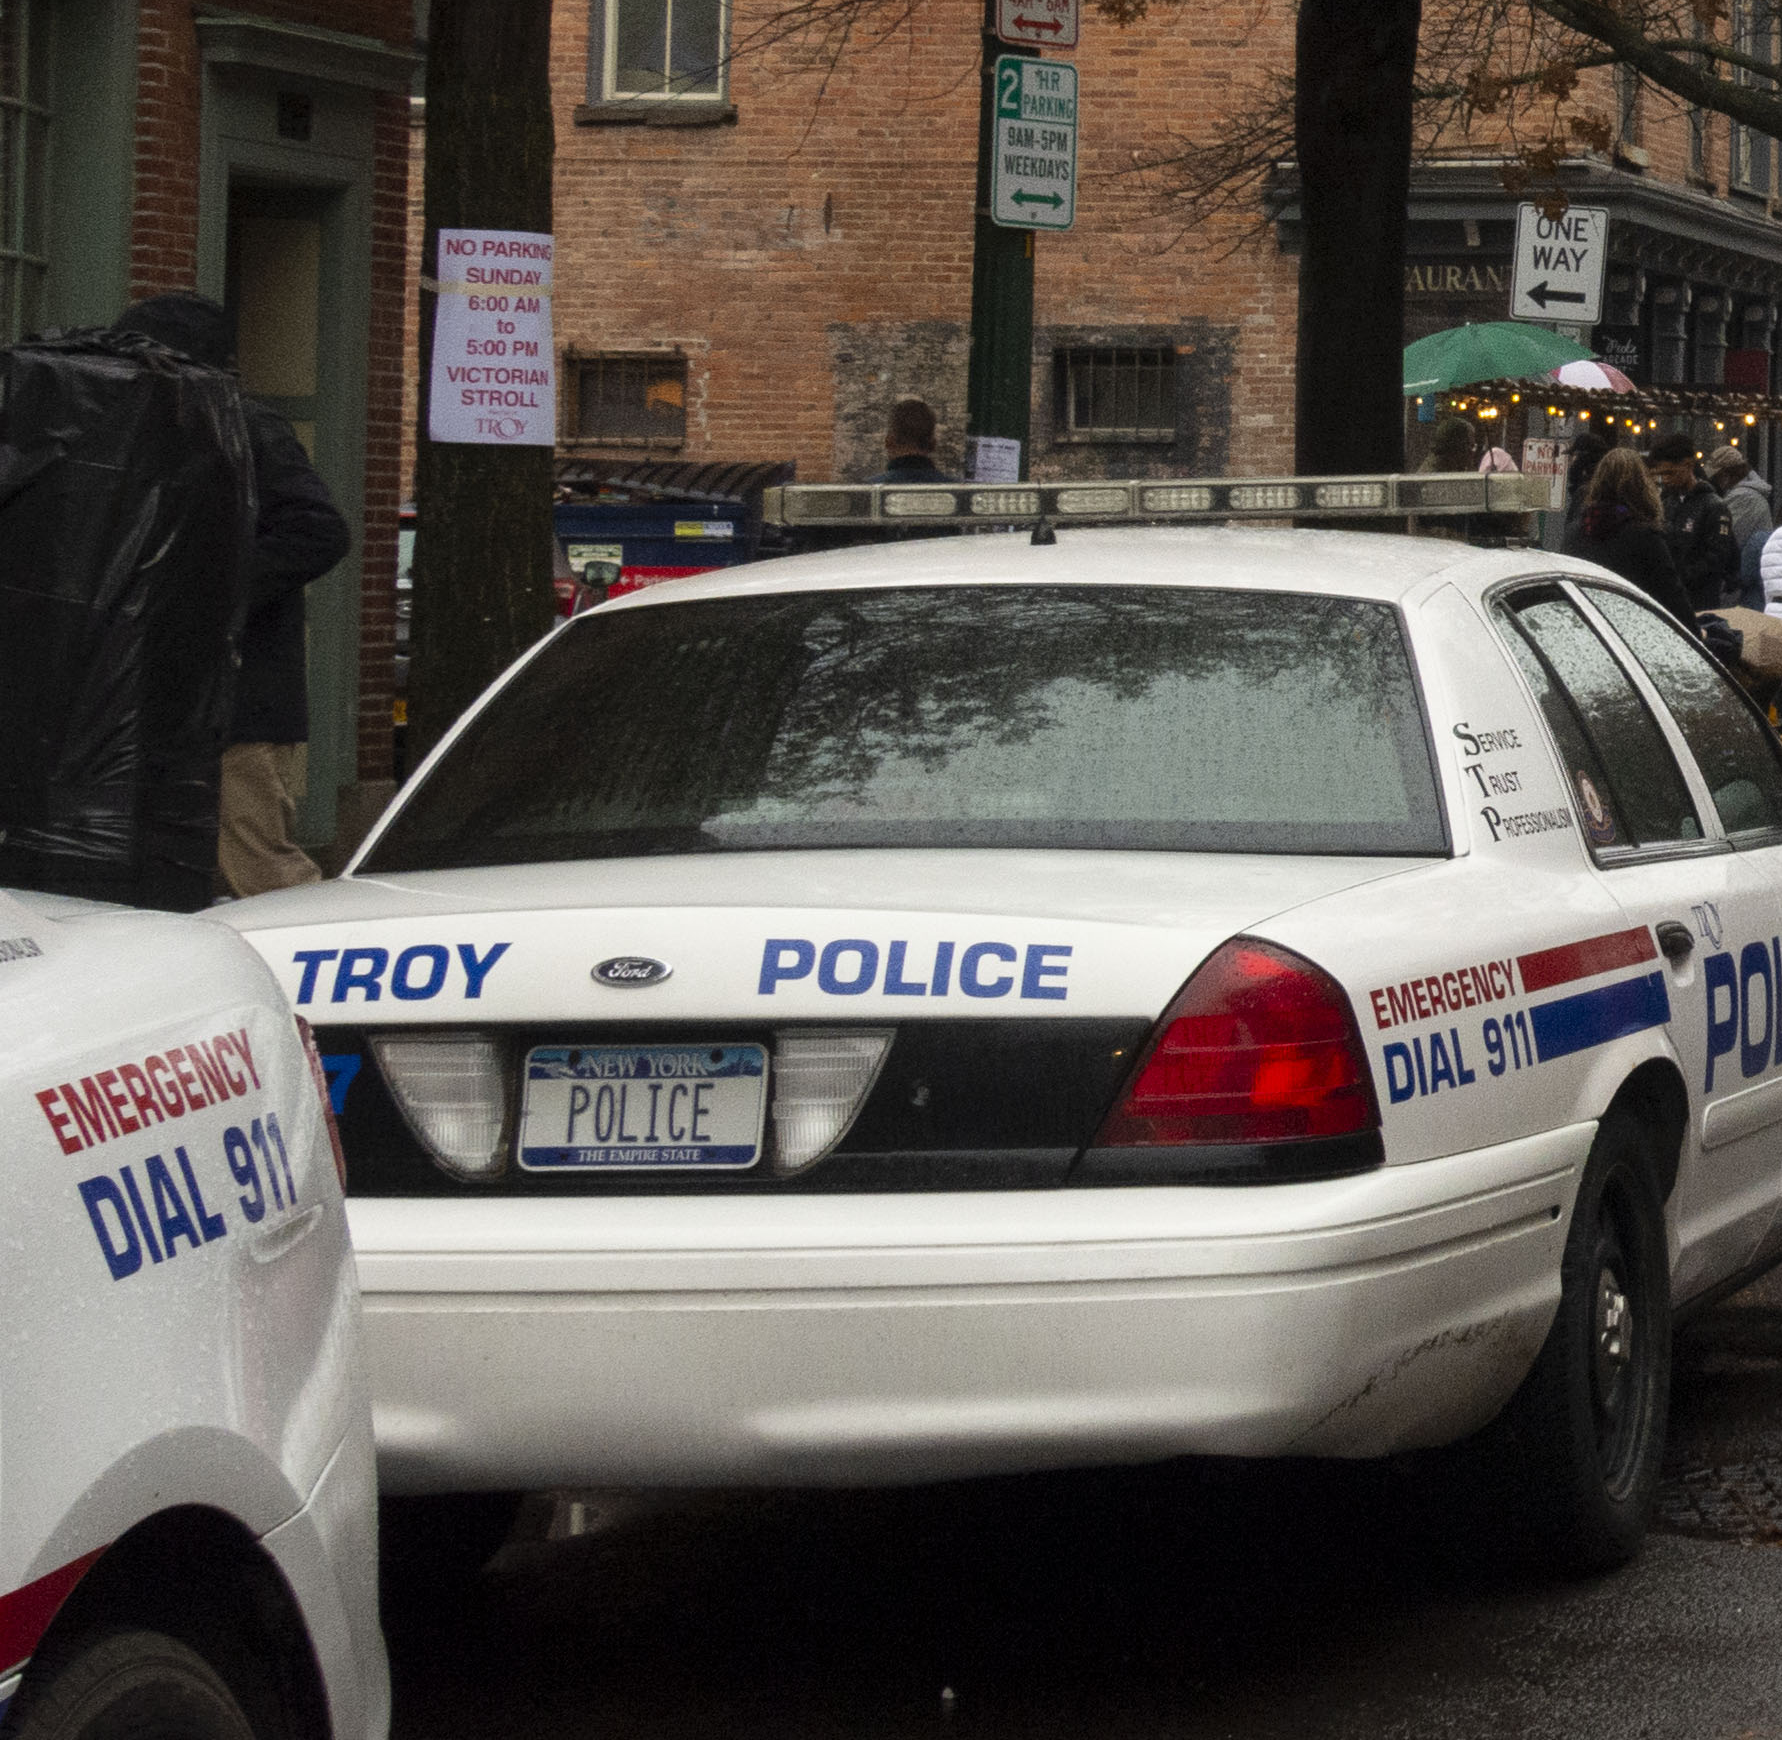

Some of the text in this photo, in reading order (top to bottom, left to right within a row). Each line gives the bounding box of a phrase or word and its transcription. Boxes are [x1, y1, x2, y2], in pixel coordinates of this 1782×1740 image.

[1000, 68, 1019, 110] 2
[1038, 70, 1061, 92] HR
[1023, 94, 1074, 120] PARKING
[1007, 126, 1068, 153] 9AM-5PM
[1004, 153, 1070, 182] WEEKDAYS
[1535, 215, 1589, 243] ONE
[446, 238, 552, 260] NO PARKING
[1533, 245, 1589, 273] WAY
[466, 267, 542, 286] SUNDAY
[1404, 264, 1514, 292] AURAN
[468, 295, 541, 313] 6:00 AM
[496, 318, 516, 335] to
[466, 339, 539, 357] 5:00 PM
[446, 365, 549, 386] VICTORIAN
[460, 389, 539, 408] STROLL
[1537, 445, 1554, 459] NO
[1526, 461, 1565, 476] PARKING
[292, 942, 514, 1005] TROY
[607, 961, 655, 979] Ford
[757, 938, 1074, 1001] POLICE
[1369, 958, 1515, 1030] EMERGENCY
[584, 1051, 709, 1078] NEW YORK
[1383, 1007, 1535, 1105] DIAL 911
[35, 1028, 262, 1157] EMERGENCY
[567, 1082, 716, 1144] POLICE
[578, 1148, 701, 1162] THE EMPIRE STATE
[77, 1112, 298, 1282] DIAL 911
